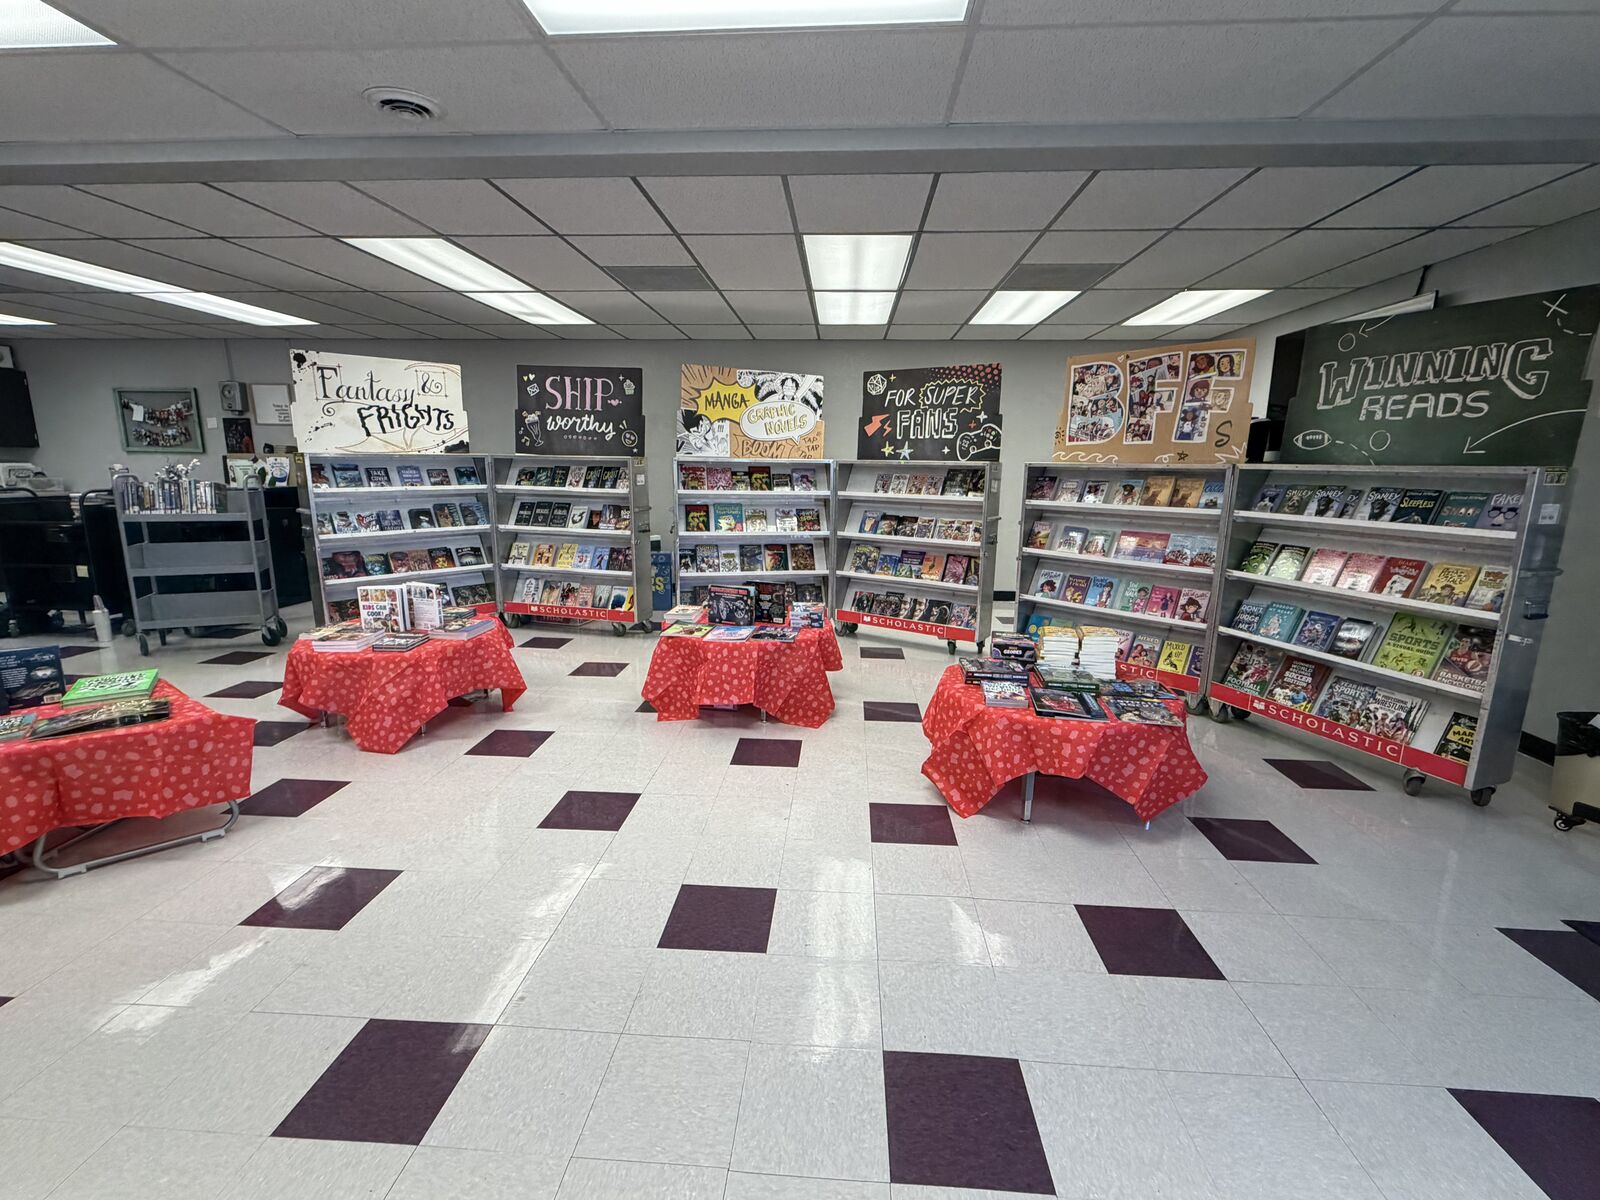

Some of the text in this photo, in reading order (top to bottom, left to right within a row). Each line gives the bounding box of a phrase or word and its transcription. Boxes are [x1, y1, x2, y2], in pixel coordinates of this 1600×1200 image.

[1317, 338, 1553, 410] WINNING
[316, 366, 415, 407] Fantasy
[545, 375, 614, 411] SHIP
[884, 386, 978, 407] FOR SUPER
[704, 391, 750, 411] MANGA
[1359, 390, 1492, 421] READS
[357, 404, 455, 437] FRIGHTS
[747, 403, 796, 424] GRAPHIC
[896, 407, 959, 439] FANS
[546, 414, 616, 441] worthy
[764, 414, 808, 436] NOVELS
[540, 606, 606, 618] SCHOLASTIC
[872, 617, 944, 635] SCHOLASTIC
[1388, 632, 1440, 650] SPORTS
[1226, 676, 1261, 692] FOOTBALL
[1284, 670, 1312, 684] SOCCER
[1437, 677, 1485, 692] ENCYCLOPE
[1438, 671, 1487, 687] BASKETBA
[1333, 684, 1366, 700] SPORTS
[1268, 704, 1399, 757] SCHOLASTIC
